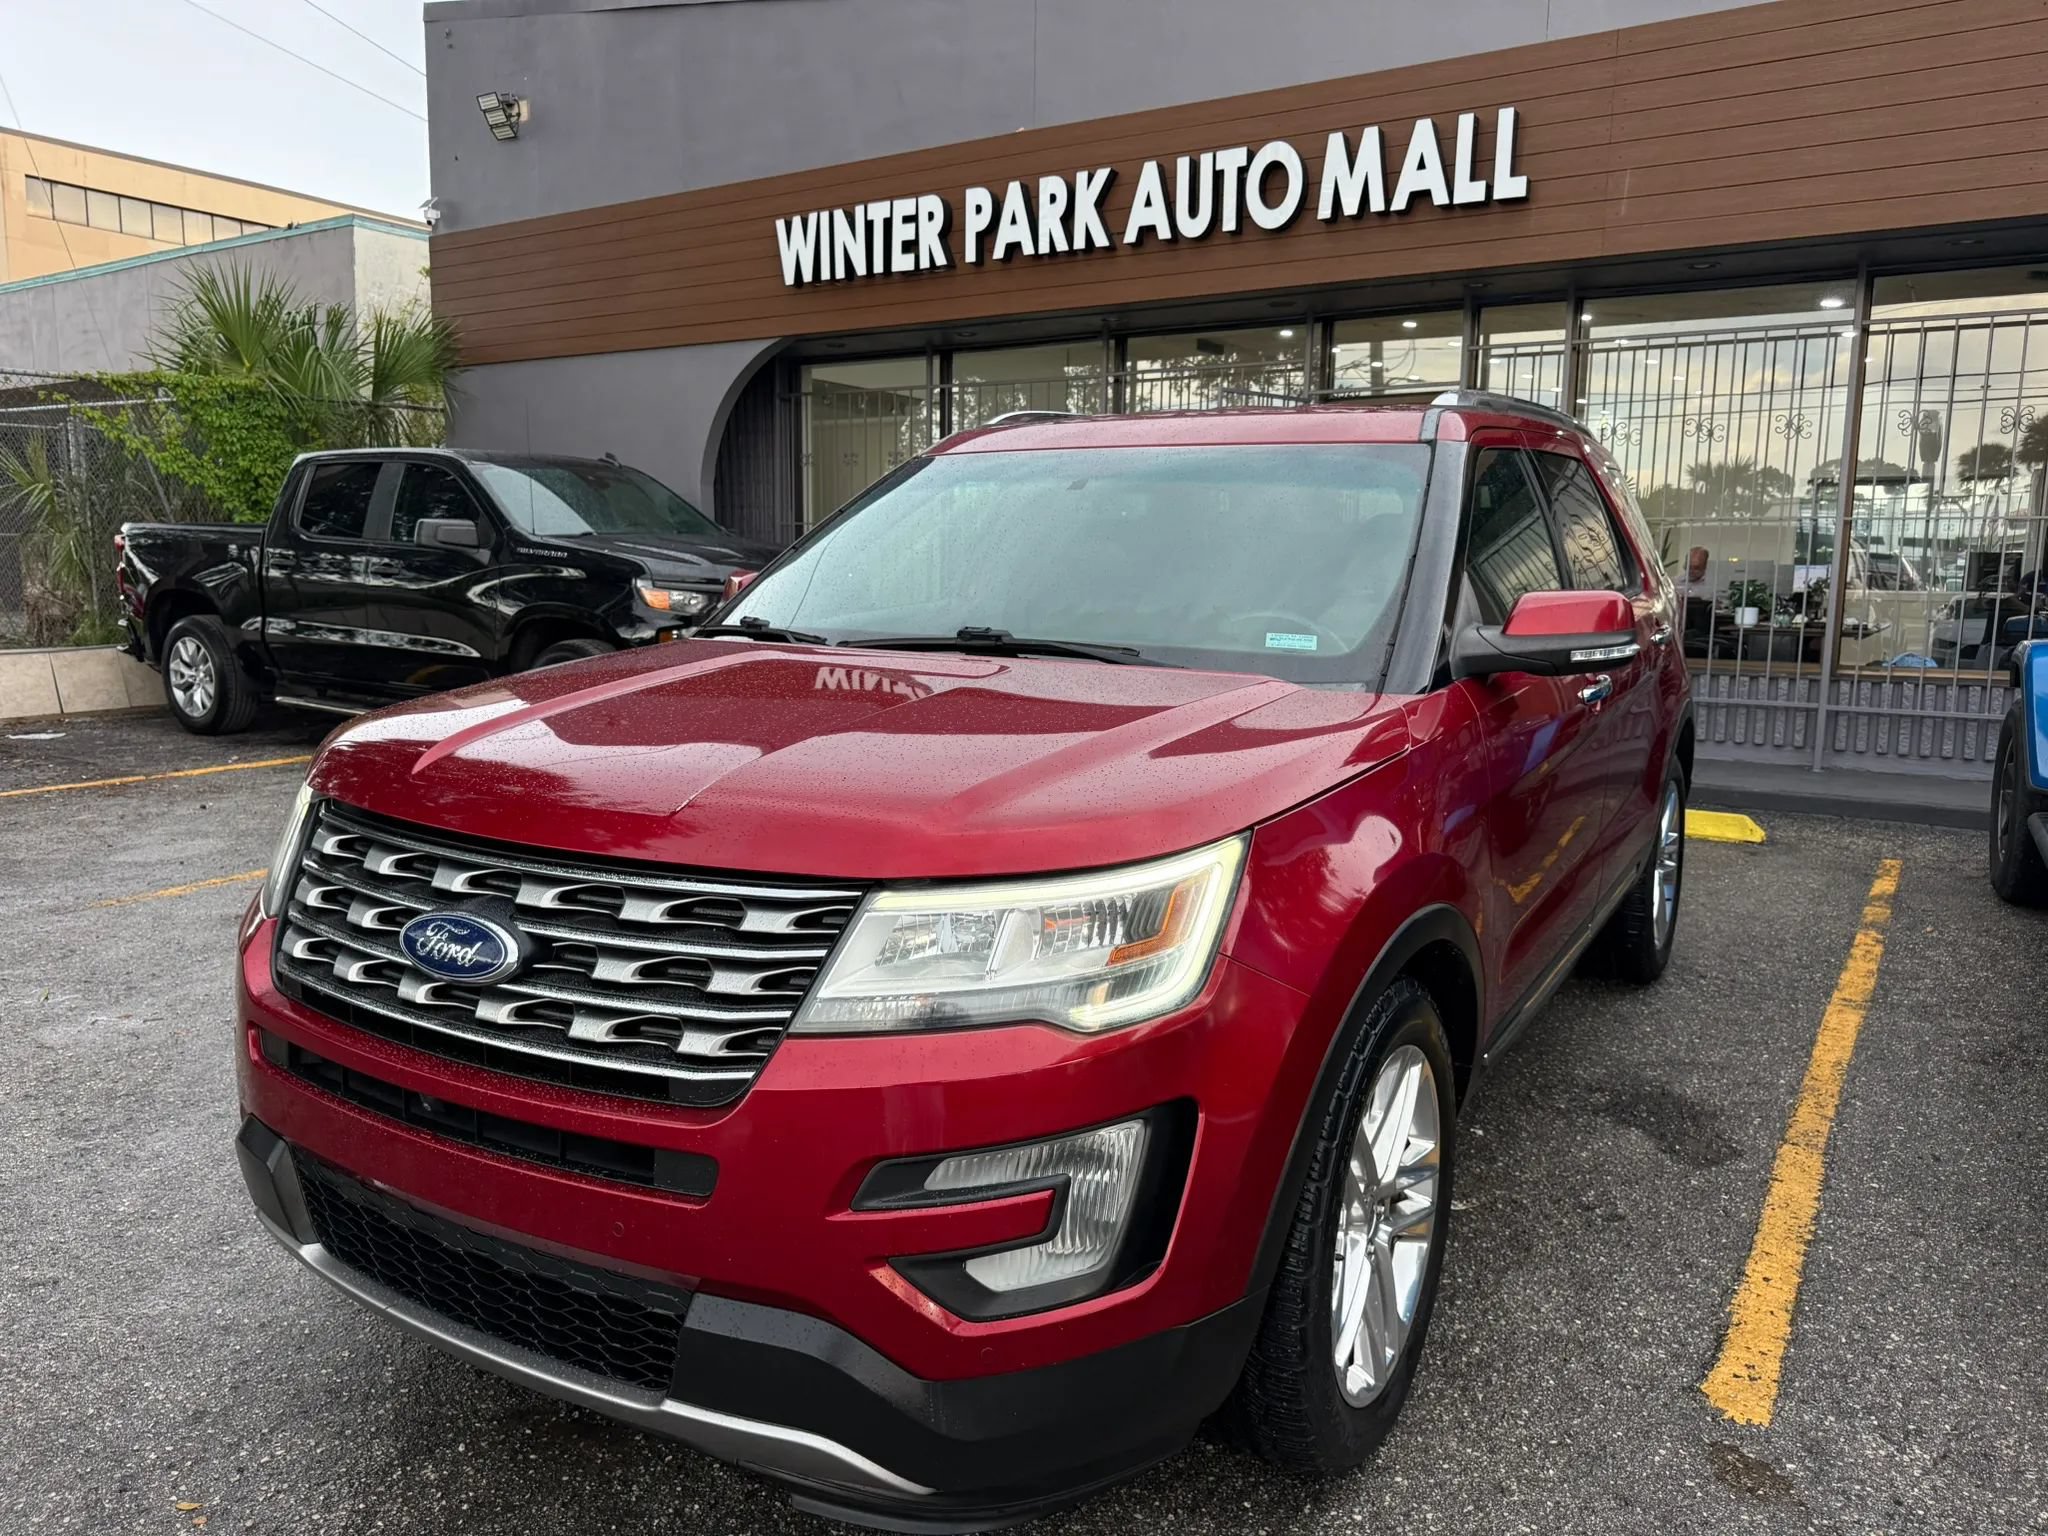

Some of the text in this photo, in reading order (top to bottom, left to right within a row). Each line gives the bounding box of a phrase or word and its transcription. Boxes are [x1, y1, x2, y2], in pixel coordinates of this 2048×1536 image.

[775, 106, 1529, 287] WINTER PARK AUTO MALL
[416, 920, 483, 967] Ford
